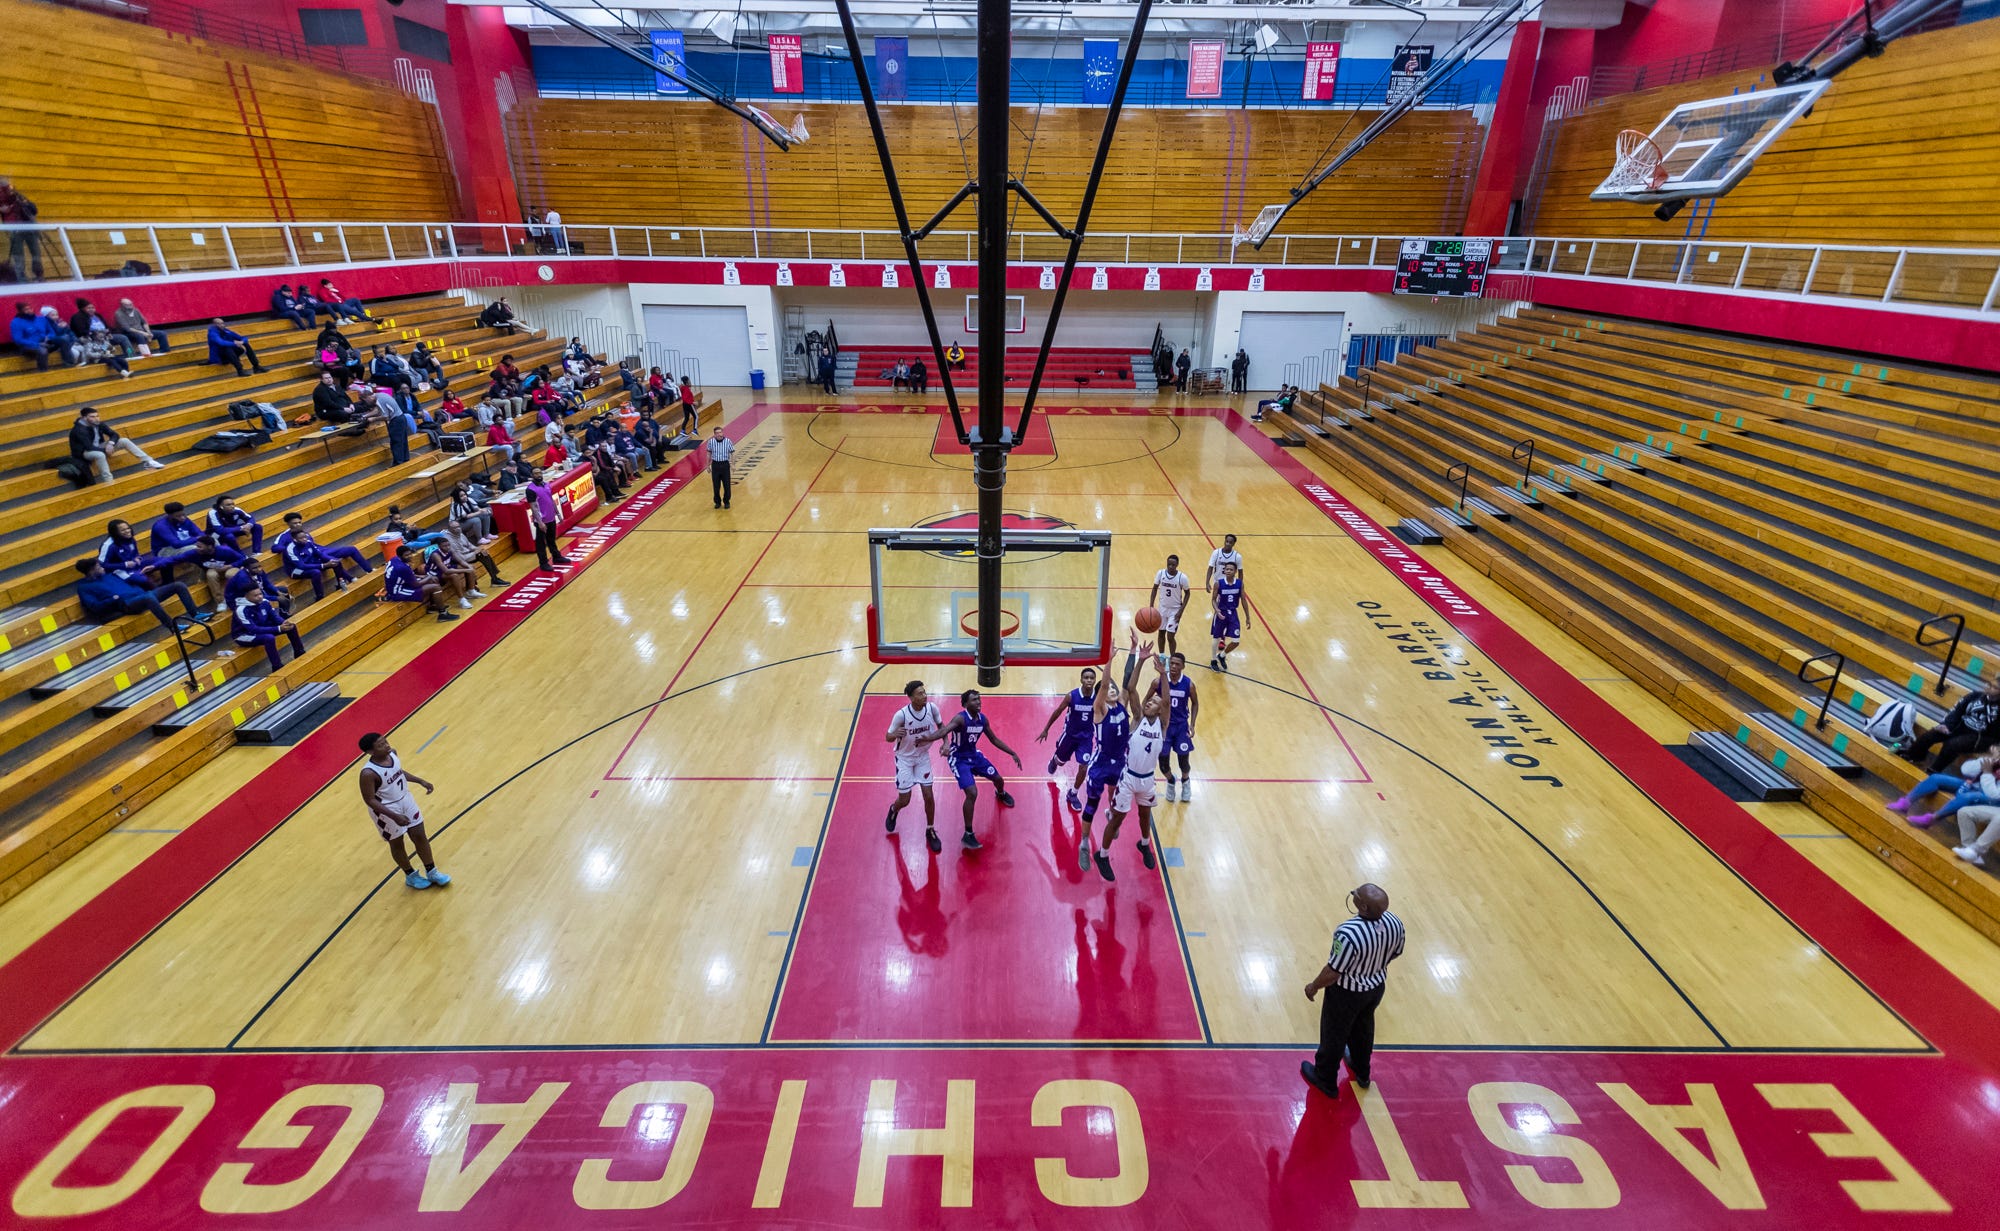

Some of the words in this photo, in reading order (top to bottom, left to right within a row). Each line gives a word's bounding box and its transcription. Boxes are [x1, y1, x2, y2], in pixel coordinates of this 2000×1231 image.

[1408, 261, 1419, 272] 10
[1467, 262, 1484, 274] 21
[1401, 277, 1408, 288] 6
[1471, 280, 1479, 291] 6
[816, 405, 1172, 415] CARDNALS
[638, 478, 680, 500] Learning
[627, 501, 653, 510] For
[552, 564, 574, 574] IT
[1399, 560, 1428, 573] For
[500, 576, 560, 608] TAKES!
[1166, 589, 1171, 597] 3
[1418, 576, 1480, 616] Learning
[1356, 601, 1455, 681] BARATTO
[1411, 621, 1470, 666] CENTER
[139, 665, 148, 676] C
[253, 700, 260, 710] A
[1172, 698, 1179, 708] 0
[1462, 670, 1558, 745] ATHLETIC
[1082, 713, 1089, 721] 5
[909, 726, 931, 736] CARDINALS
[1117, 724, 1122, 736] 1
[1145, 742, 1152, 754] 4
[1465, 718, 1564, 787] JOHN
[397, 779, 403, 791] 7
[12, 1080, 1150, 1218] CHICAGO
[1350, 1081, 1953, 1212] EAST
